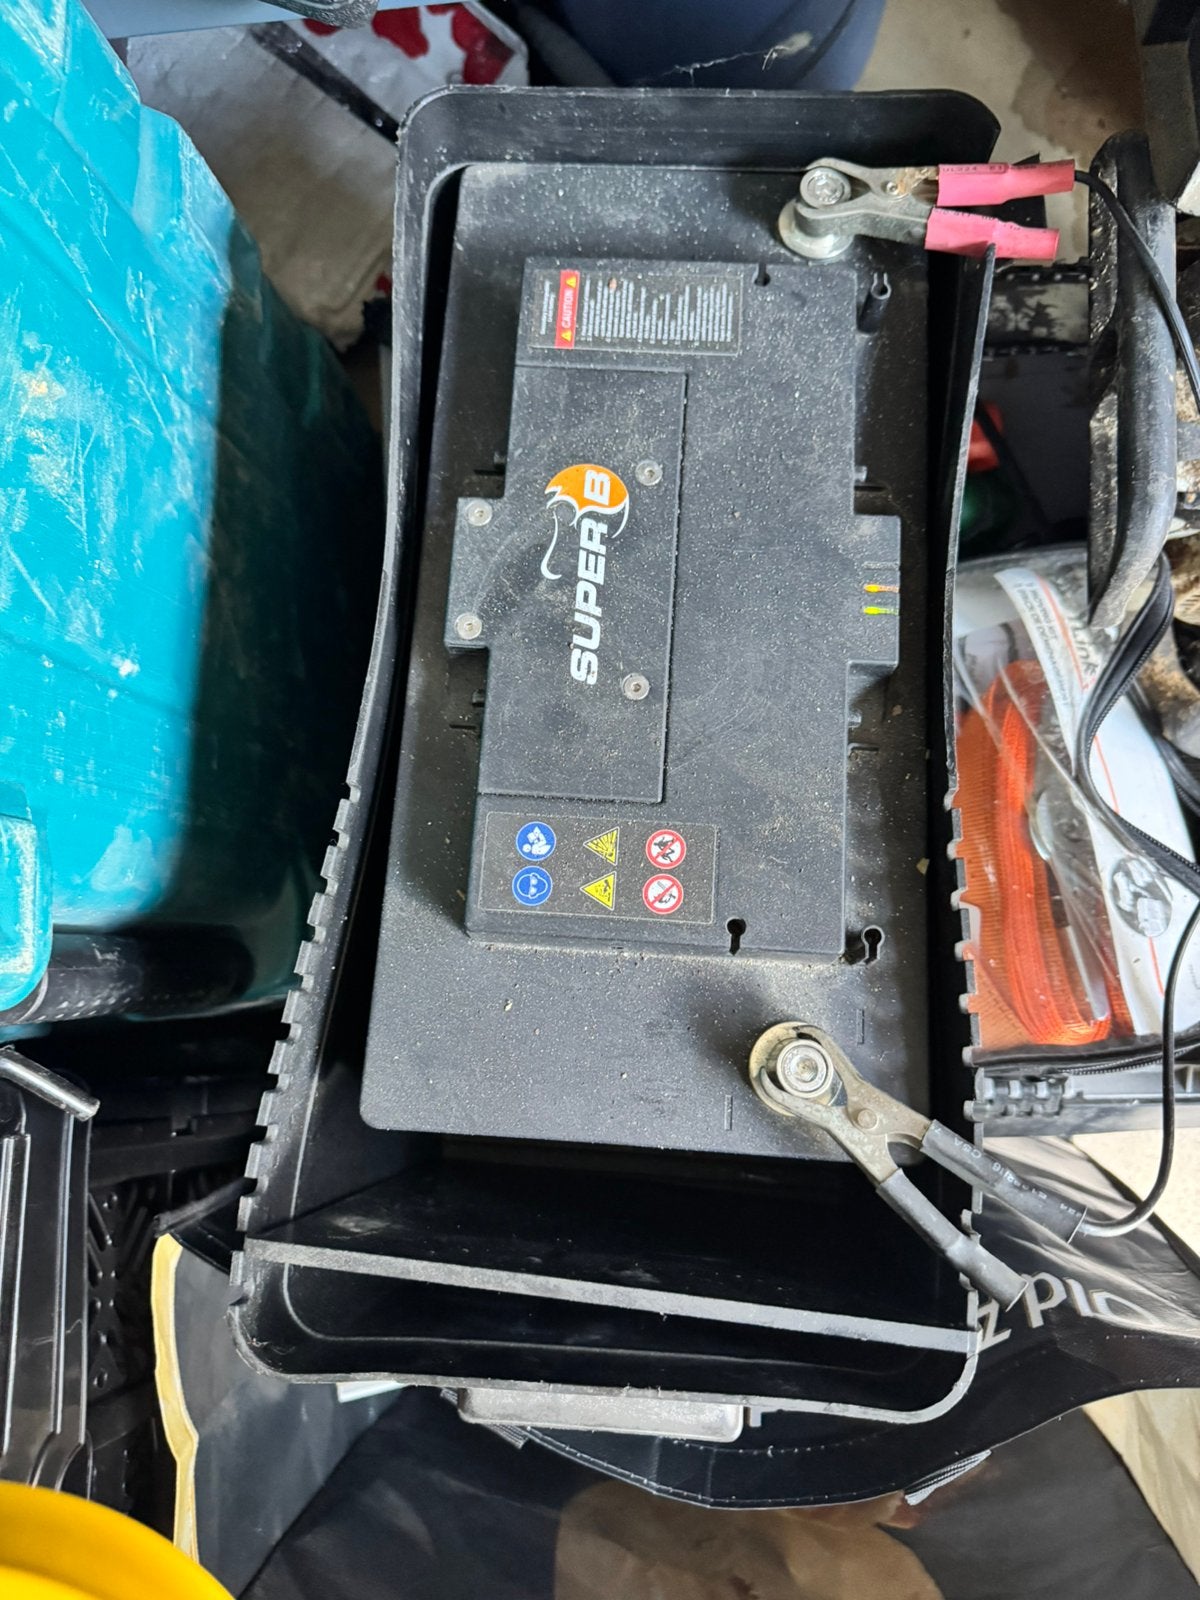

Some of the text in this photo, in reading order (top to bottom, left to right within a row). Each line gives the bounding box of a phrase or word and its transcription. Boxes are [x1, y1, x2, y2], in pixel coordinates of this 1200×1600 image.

[561, 287, 574, 329] CAUTION
[570, 468, 611, 685] SUPER B
[953, 1136, 983, 1160] CSA
